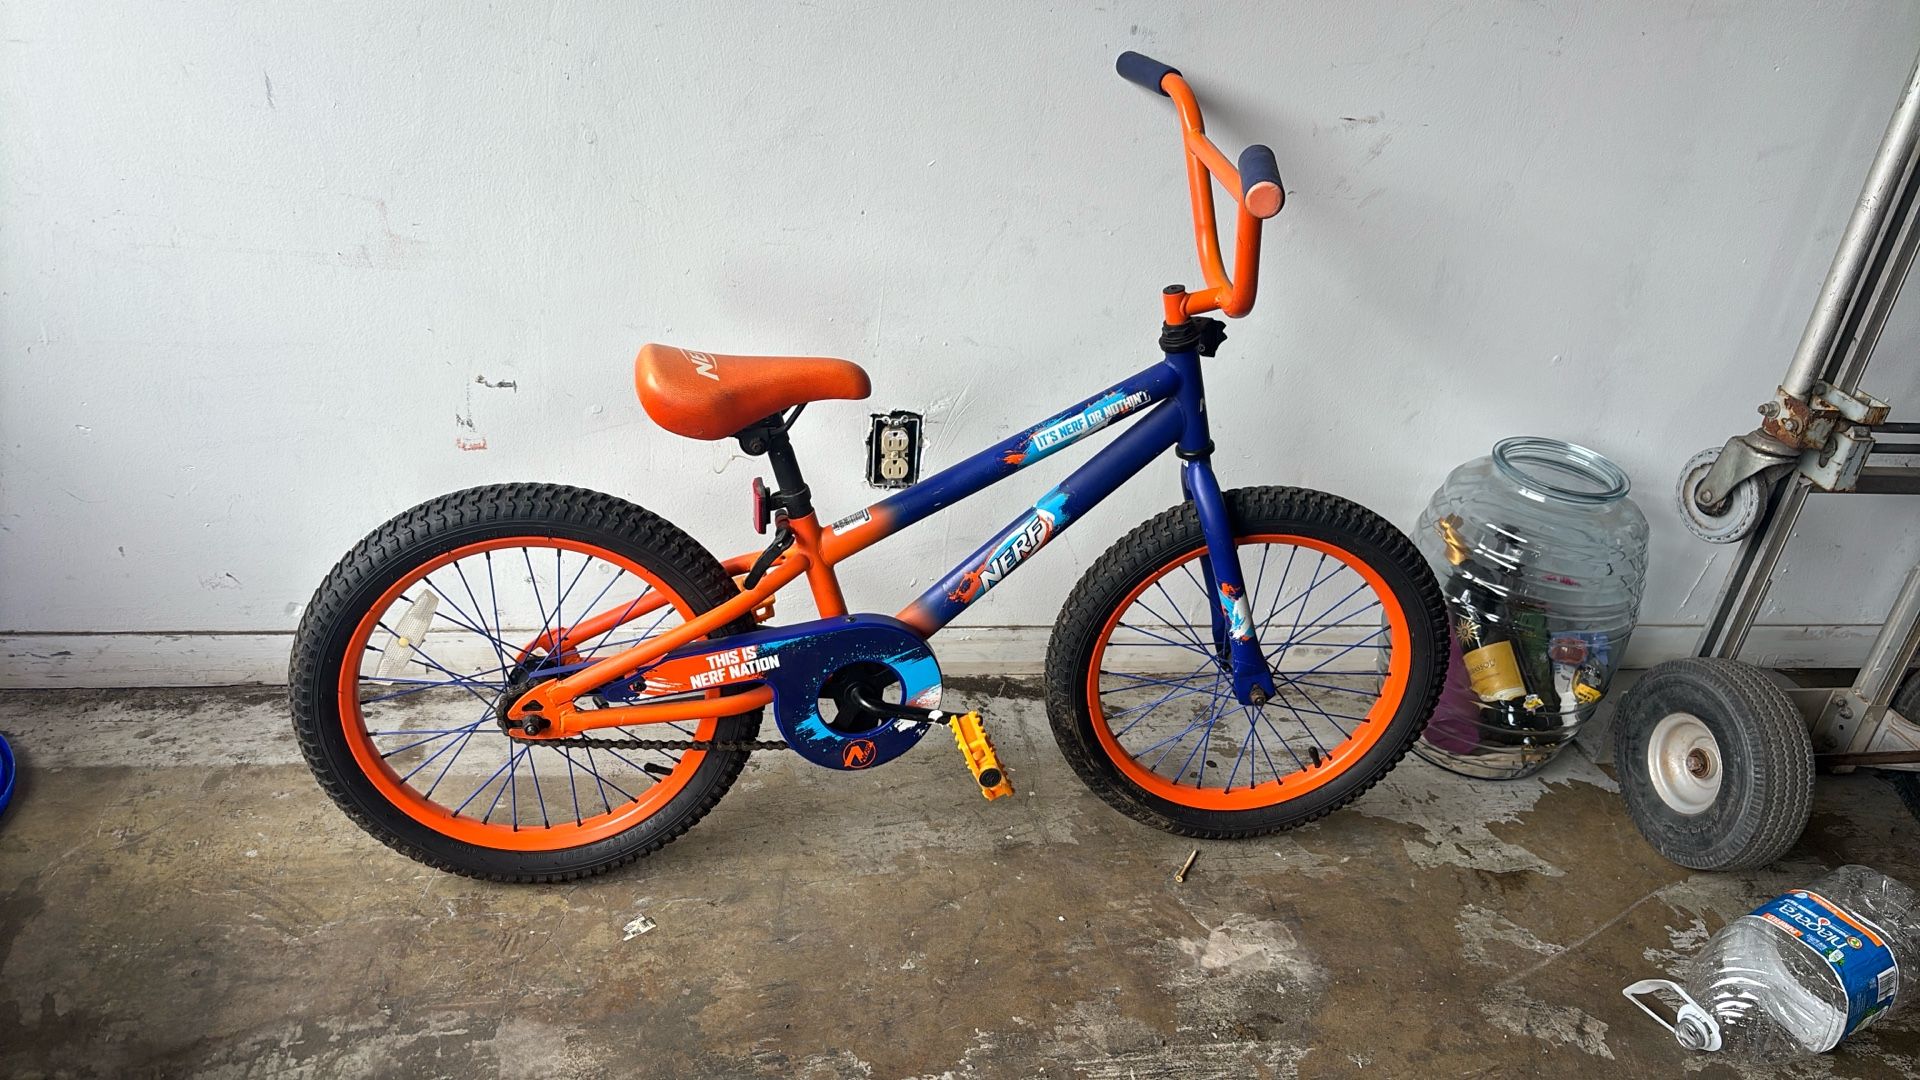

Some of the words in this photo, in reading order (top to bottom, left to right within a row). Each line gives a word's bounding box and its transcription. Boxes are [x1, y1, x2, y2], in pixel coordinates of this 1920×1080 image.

[689, 351, 720, 382] NE
[1037, 431, 1059, 448] IT'S
[1058, 418, 1085, 439] NERF
[1087, 410, 1106, 426] OR
[979, 517, 1044, 593] NERF
[689, 668, 726, 690] NERF
[728, 654, 781, 679] NATION
[705, 650, 740, 670] THIS
[741, 645, 757, 661] IS
[1779, 903, 1848, 949] niagara
